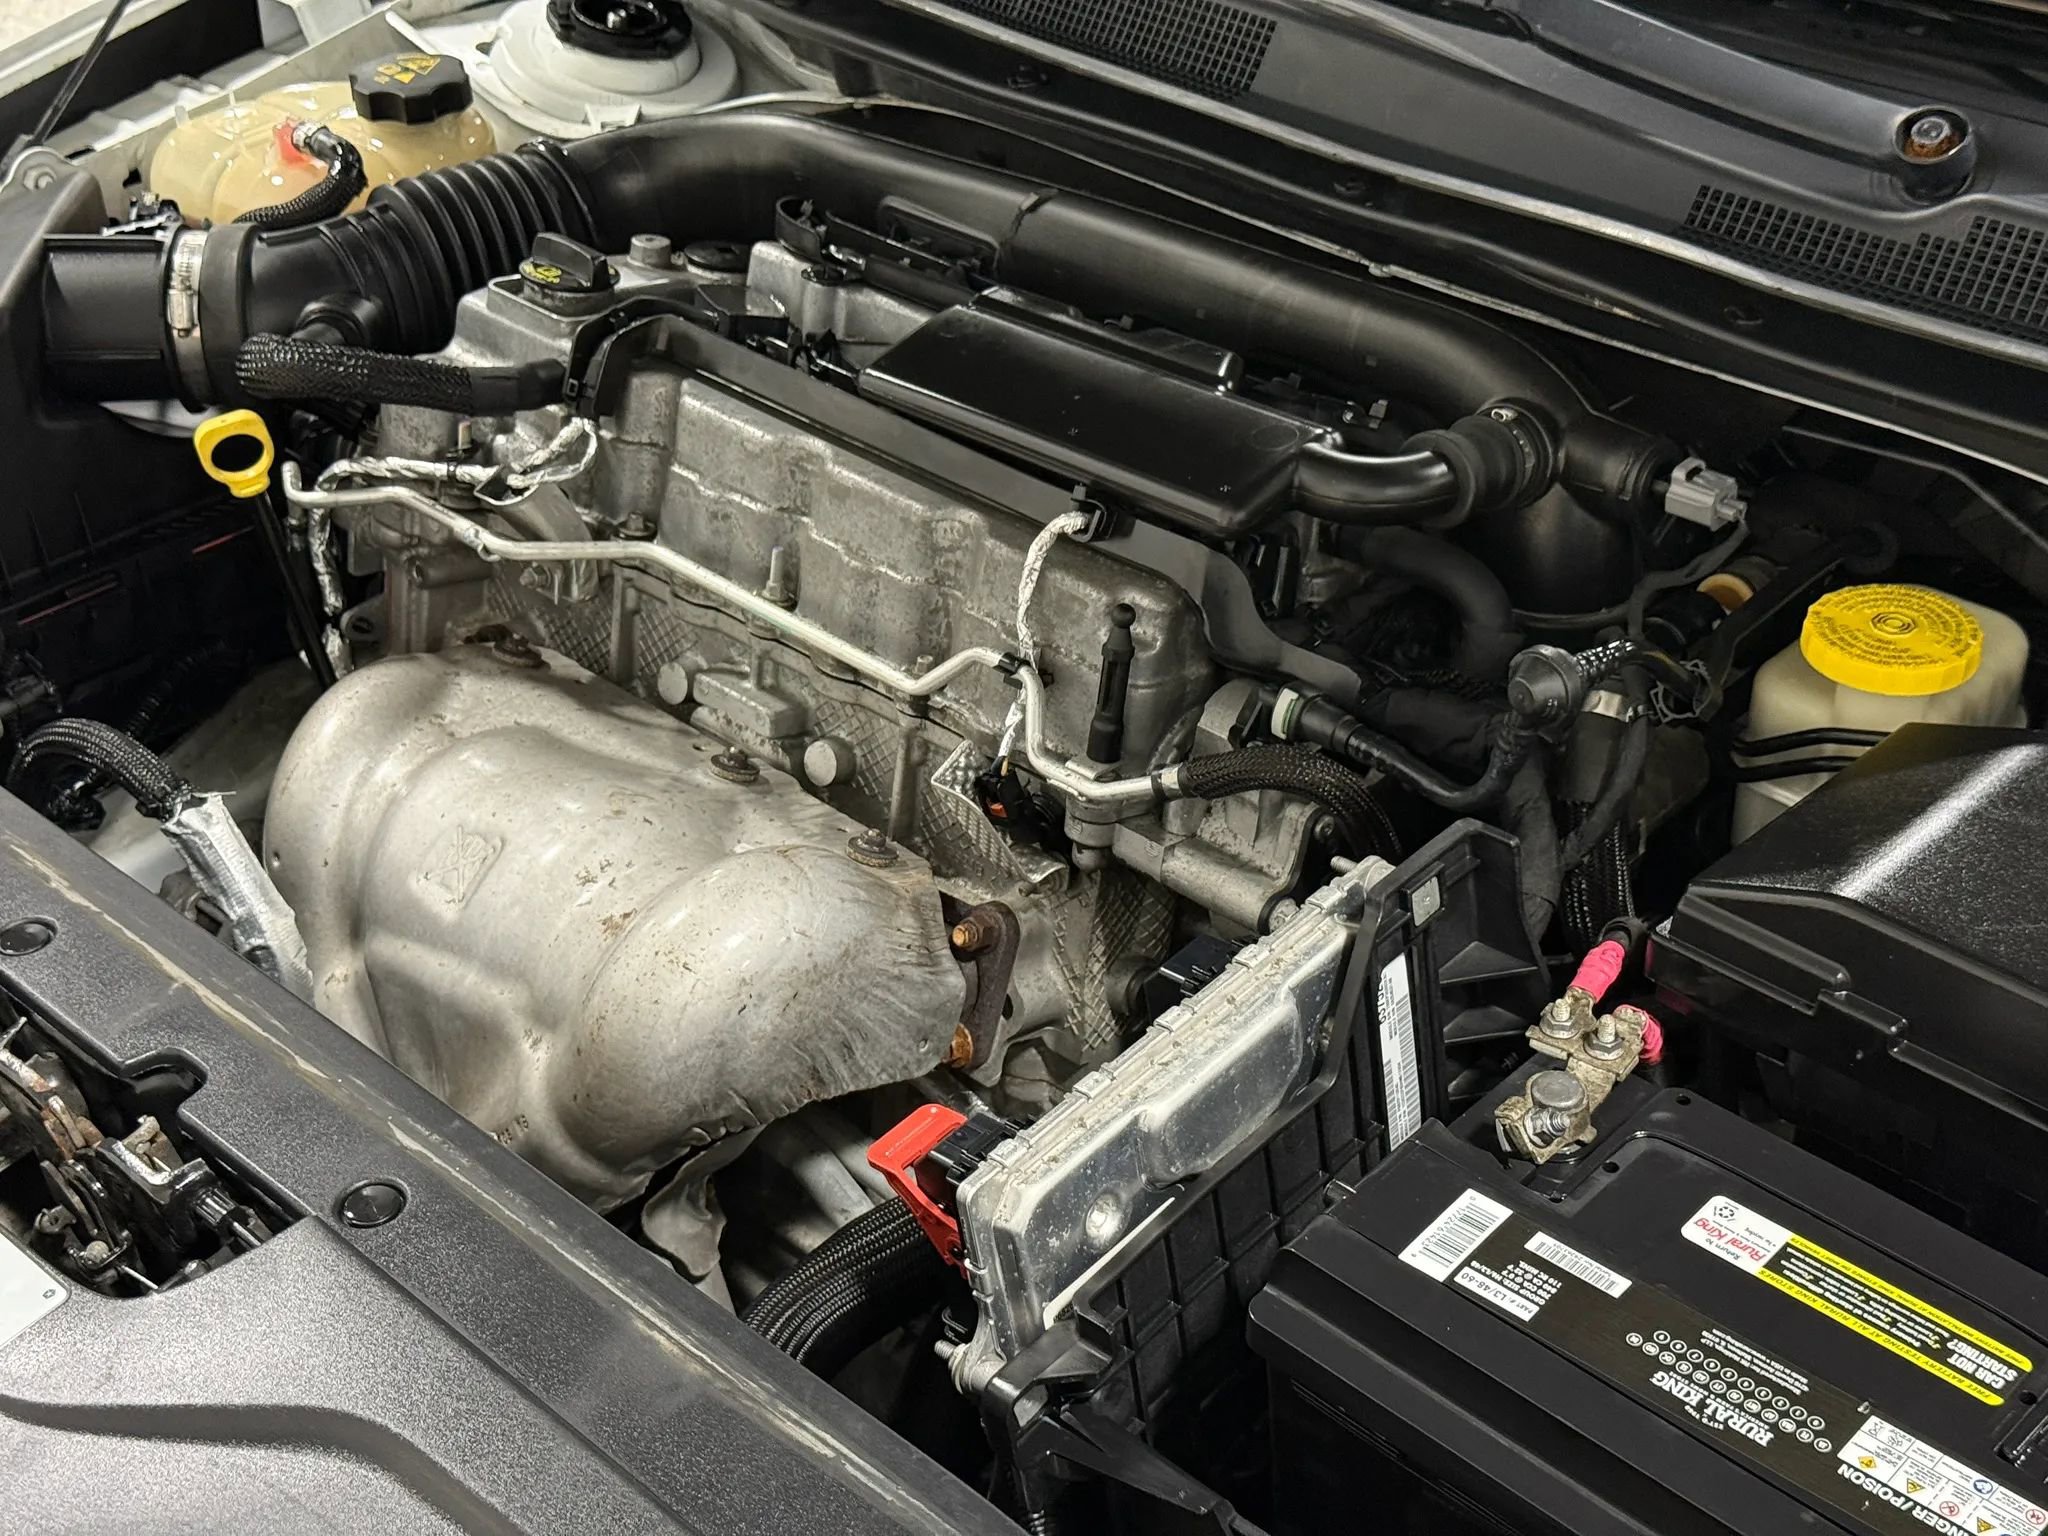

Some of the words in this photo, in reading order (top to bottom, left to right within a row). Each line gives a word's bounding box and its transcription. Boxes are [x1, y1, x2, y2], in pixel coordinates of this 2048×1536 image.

[1694, 1218, 1730, 1240] King
[1715, 1244, 1740, 1260] Return
[1725, 1238, 1766, 1261] Rural
[1462, 1273, 1507, 1300] L3/48-60
[1523, 1281, 1537, 1291] CCA
[1532, 1277, 1543, 1286] CA
[1548, 1278, 1561, 1288] 110
[1759, 1270, 1794, 1290] STORES
[1519, 1289, 1545, 1305] GROUP
[1795, 1290, 1817, 1302] KING
[1516, 1303, 1532, 1313] PART
[1821, 1304, 1850, 1320] RURAL
[1852, 1320, 1869, 1331] ALL
[1869, 1330, 1881, 1338] AT
[1883, 1338, 1921, 1360] TESTING
[1947, 1339, 2017, 1380] STARTING?
[1947, 1354, 1977, 1373] NOT
[1923, 1361, 1964, 1383] BATTERY
[1975, 1367, 2005, 1388] CAR
[1650, 1371, 1703, 1406] KING
[1966, 1384, 1990, 1398] FREE
[1704, 1398, 1774, 1446] RURAL
